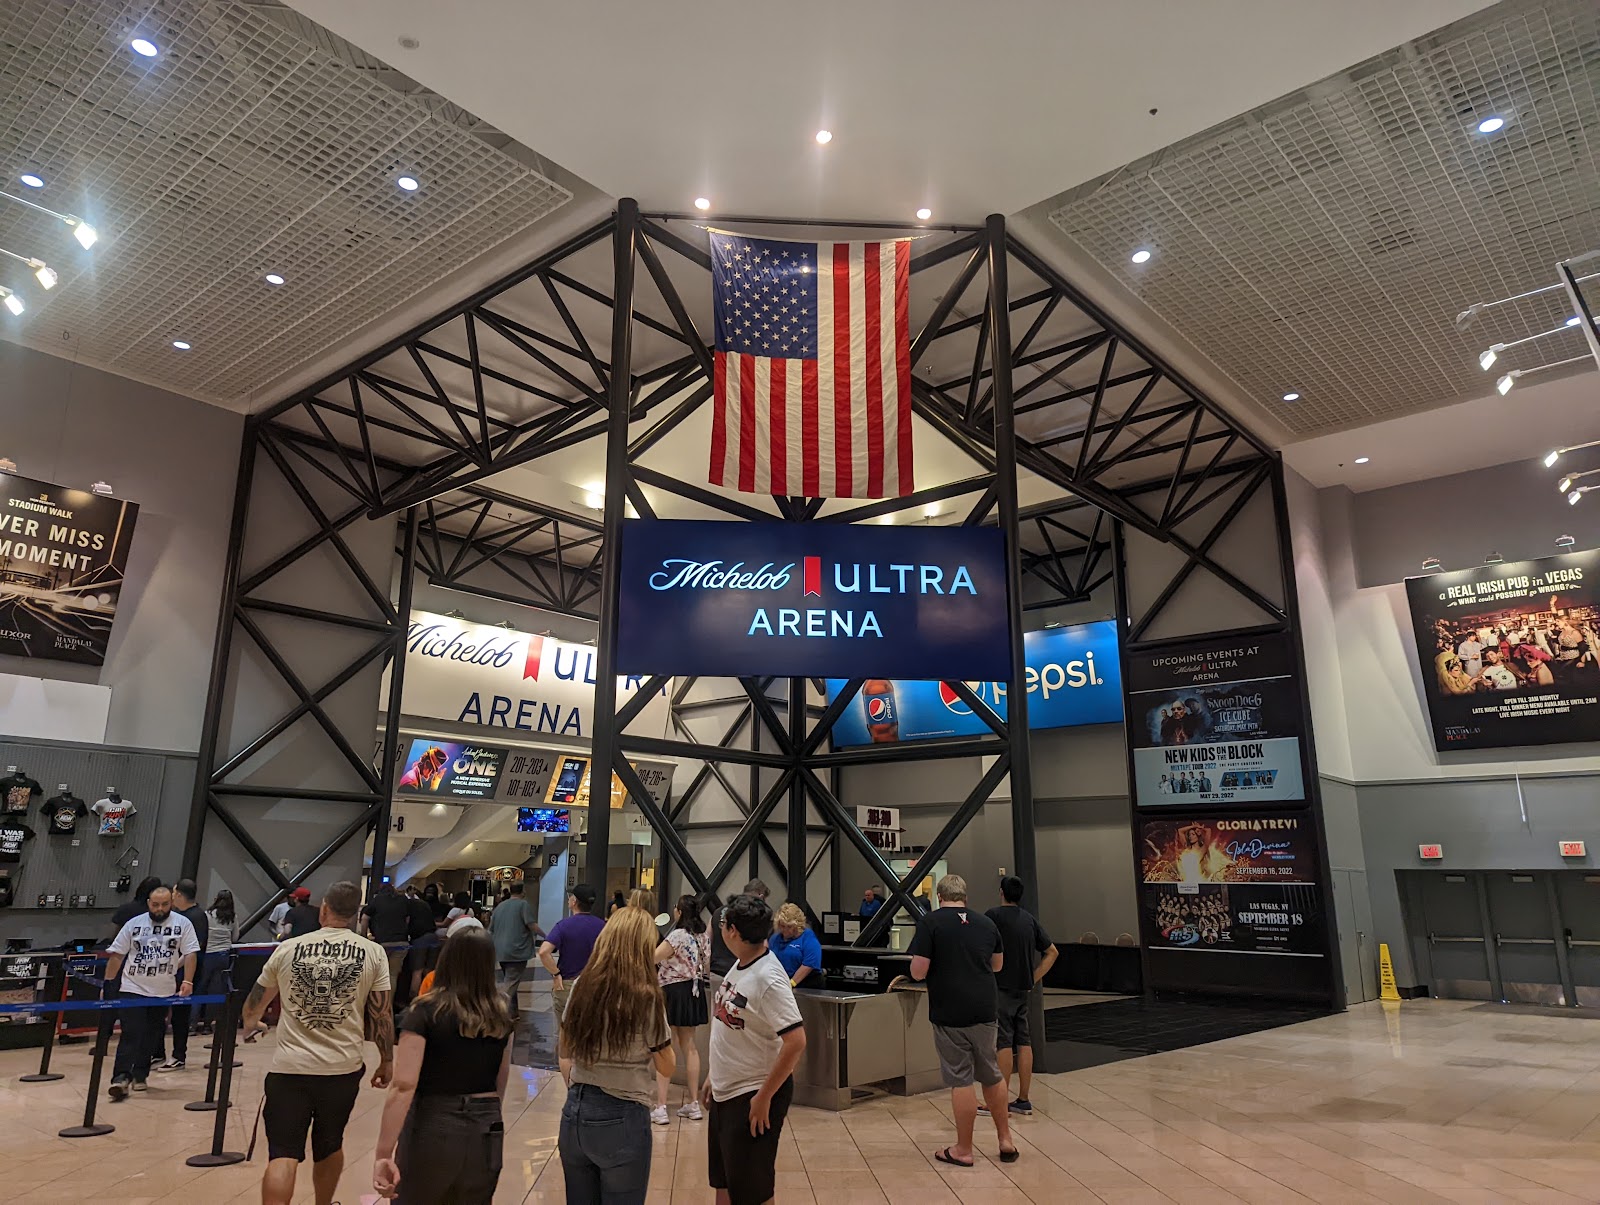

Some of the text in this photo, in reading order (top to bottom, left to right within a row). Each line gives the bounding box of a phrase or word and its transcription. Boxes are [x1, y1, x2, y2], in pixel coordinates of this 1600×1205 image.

[9, 499, 47, 513] STADIUM
[49, 507, 73, 519] WALK
[49, 524, 105, 551] MISS
[649, 559, 978, 595] Michelob ULTRA
[1447, 584, 1475, 599] REAL
[1476, 579, 1505, 595] IRISH
[1506, 576, 1529, 590] PUB
[1532, 577, 1544, 587] in
[1545, 567, 1583, 584] VEGAS
[1458, 597, 1477, 606] WHAT
[1478, 595, 1494, 603] could
[1495, 589, 1528, 600] POSSIBLY
[1538, 583, 1570, 594] WRONG?
[748, 608, 884, 638] ARENA
[54, 641, 77, 650] PLACE
[56, 635, 94, 647] MANDALAY
[1152, 646, 1260, 667] UPCOMING EVENTS AT
[1208, 660, 1238, 670] ULTRA
[1192, 672, 1220, 681] ARENA
[1206, 692, 1262, 709] SNOOP DOGG
[1544, 699, 1570, 707] AVAILABLE
[458, 692, 582, 736] ARENA
[1220, 709, 1251, 722] ICE CUBE
[1165, 749, 1188, 764] NEW
[1190, 747, 1215, 762] KIDS
[1217, 746, 1226, 754] ON
[1228, 743, 1264, 760] BLOCK
[453, 758, 499, 777] ONE
[510, 756, 544, 776] 201-203
[506, 779, 537, 798] 101-103
[1236, 867, 1268, 875] SEPTEMBER
[1279, 867, 1293, 875] 2022
[1238, 912, 1303, 925] SEPTEMBER 18
[293, 939, 366, 963] hardship
